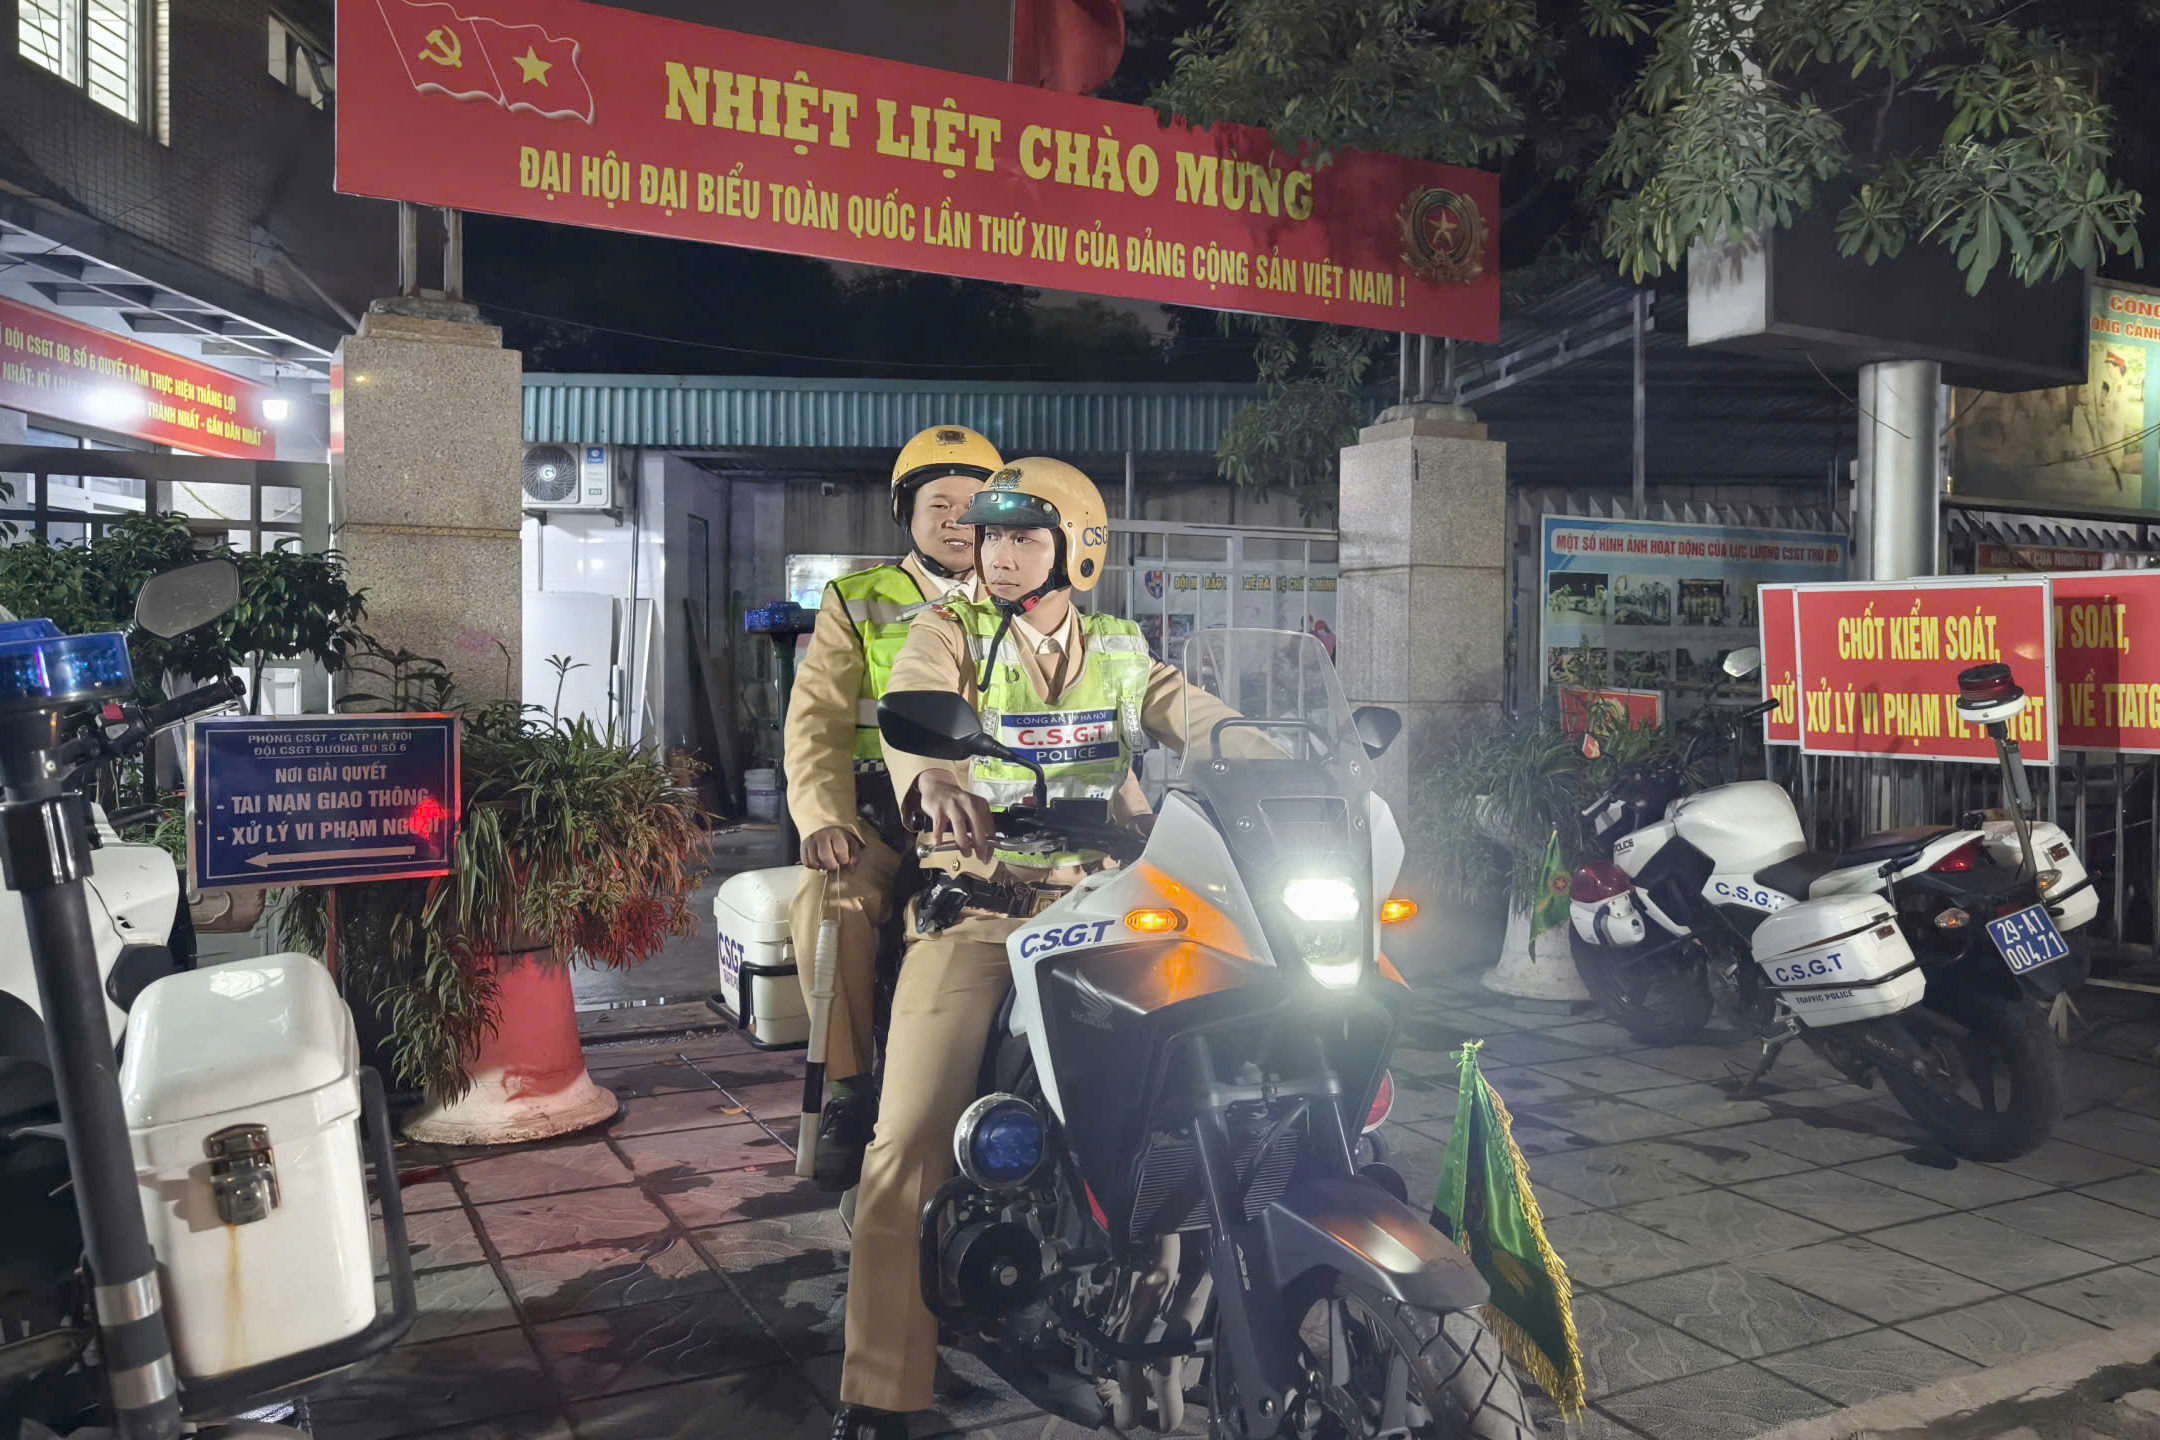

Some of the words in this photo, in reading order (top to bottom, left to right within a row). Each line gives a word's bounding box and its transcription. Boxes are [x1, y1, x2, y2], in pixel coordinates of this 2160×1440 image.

[665, 61, 858, 155] NHIỆT
[876, 97, 1001, 179] LIỆT
[1019, 124, 1160, 197] CHÀO
[520, 146, 571, 200] ĐẠI
[581, 150, 630, 208] HỘI
[640, 164, 687, 216] ĐẠI
[698, 162, 760, 220] BIỂU
[769, 180, 839, 230] TOÀN
[848, 188, 916, 242] QUỐC
[924, 196, 971, 249] LẦN
[979, 211, 1026, 256] THỨ
[1031, 222, 1068, 262] XIV
[1075, 219, 1120, 270] CỦA
[1126, 227, 1186, 278] ĐẢNG
[1192, 241, 1249, 290] CỘNG
[1255, 245, 1297, 293] SẢN
[1303, 258, 1343, 305] VIỆT
[1350, 268, 1393, 307] NAM
[4, 326, 24, 352] ĐỘI
[27, 334, 54, 359] CSGT
[73, 345, 87, 368] SỐ
[89, 353, 96, 371] 6
[98, 356, 127, 380] QUYẾT
[150, 372, 174, 395] THỰC
[174, 379, 195, 401] HIỆN
[1556, 532, 1579, 553] MỘT
[1582, 531, 1596, 551] SỐ
[1599, 535, 1624, 552] HÌNH
[1626, 534, 1647, 553] ẢNH
[1650, 539, 1675, 557] HOẠT
[1677, 538, 1705, 558] ĐỘNG
[1838, 601, 1885, 660] CHỐT
[1890, 598, 1939, 661] KIỂM
[1945, 606, 2000, 663] SOÁT,
[2069, 594, 2130, 656] SOÁT,
[1770, 671, 1795, 724] XỬ
[1805, 677, 1832, 733] XỬ
[1835, 683, 1856, 734] LÝ
[1860, 692, 1878, 735] VI
[1884, 692, 1940, 746] PHẠM
[2069, 668, 2095, 727] VỀ
[1016, 716, 1048, 725] CÔNG
[1050, 716, 1067, 724] AN
[1017, 724, 1105, 746] C.S.G.T
[254, 746, 276, 757] ĐỘI
[280, 746, 312, 755] CSGT
[400, 743, 407, 752] 6
[296, 734, 328, 743] CSGT
[339, 733, 370, 742] CATP
[1036, 746, 1097, 762] POLICE
[275, 766, 302, 784] NƠI
[307, 761, 337, 782] GIẢI
[342, 761, 388, 782] QUYẾT
[231, 796, 260, 814] TAI
[268, 792, 311, 815] NẠN
[317, 790, 362, 810] GIAO
[368, 785, 429, 808] THÔNG
[231, 820, 262, 846] XỬ
[266, 820, 289, 843] LÝ
[295, 823, 314, 841] VI
[320, 819, 377, 841] PHẠM
[1715, 882, 1785, 910] C.S.G.T
[1020, 920, 1115, 958] C.S.G.T
[1997, 909, 2045, 945] 29-A1
[2006, 931, 2063, 969] 004.71
[1775, 953, 1842, 982] C.S.G.T
[1796, 994, 1825, 1004] TRAFFIC
[1825, 989, 1854, 1001] POLICE
